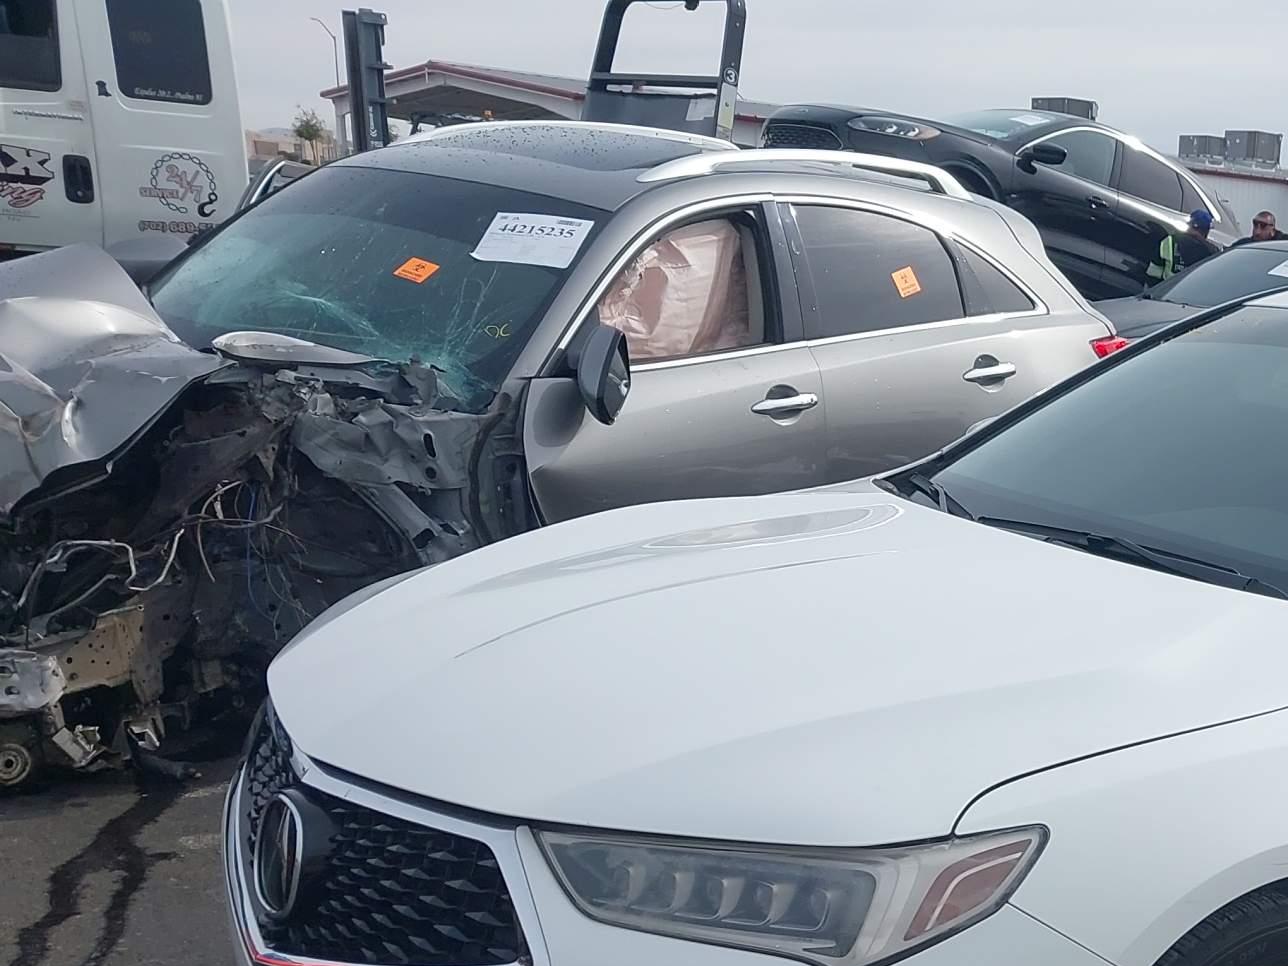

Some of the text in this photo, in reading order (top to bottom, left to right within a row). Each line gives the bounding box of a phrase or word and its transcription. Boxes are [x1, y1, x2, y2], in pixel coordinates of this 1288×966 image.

[726, 69, 735, 83] 3
[165, 164, 203, 203] 24/7
[139, 186, 179, 199] SERVICE
[498, 223, 576, 238] 44215235
